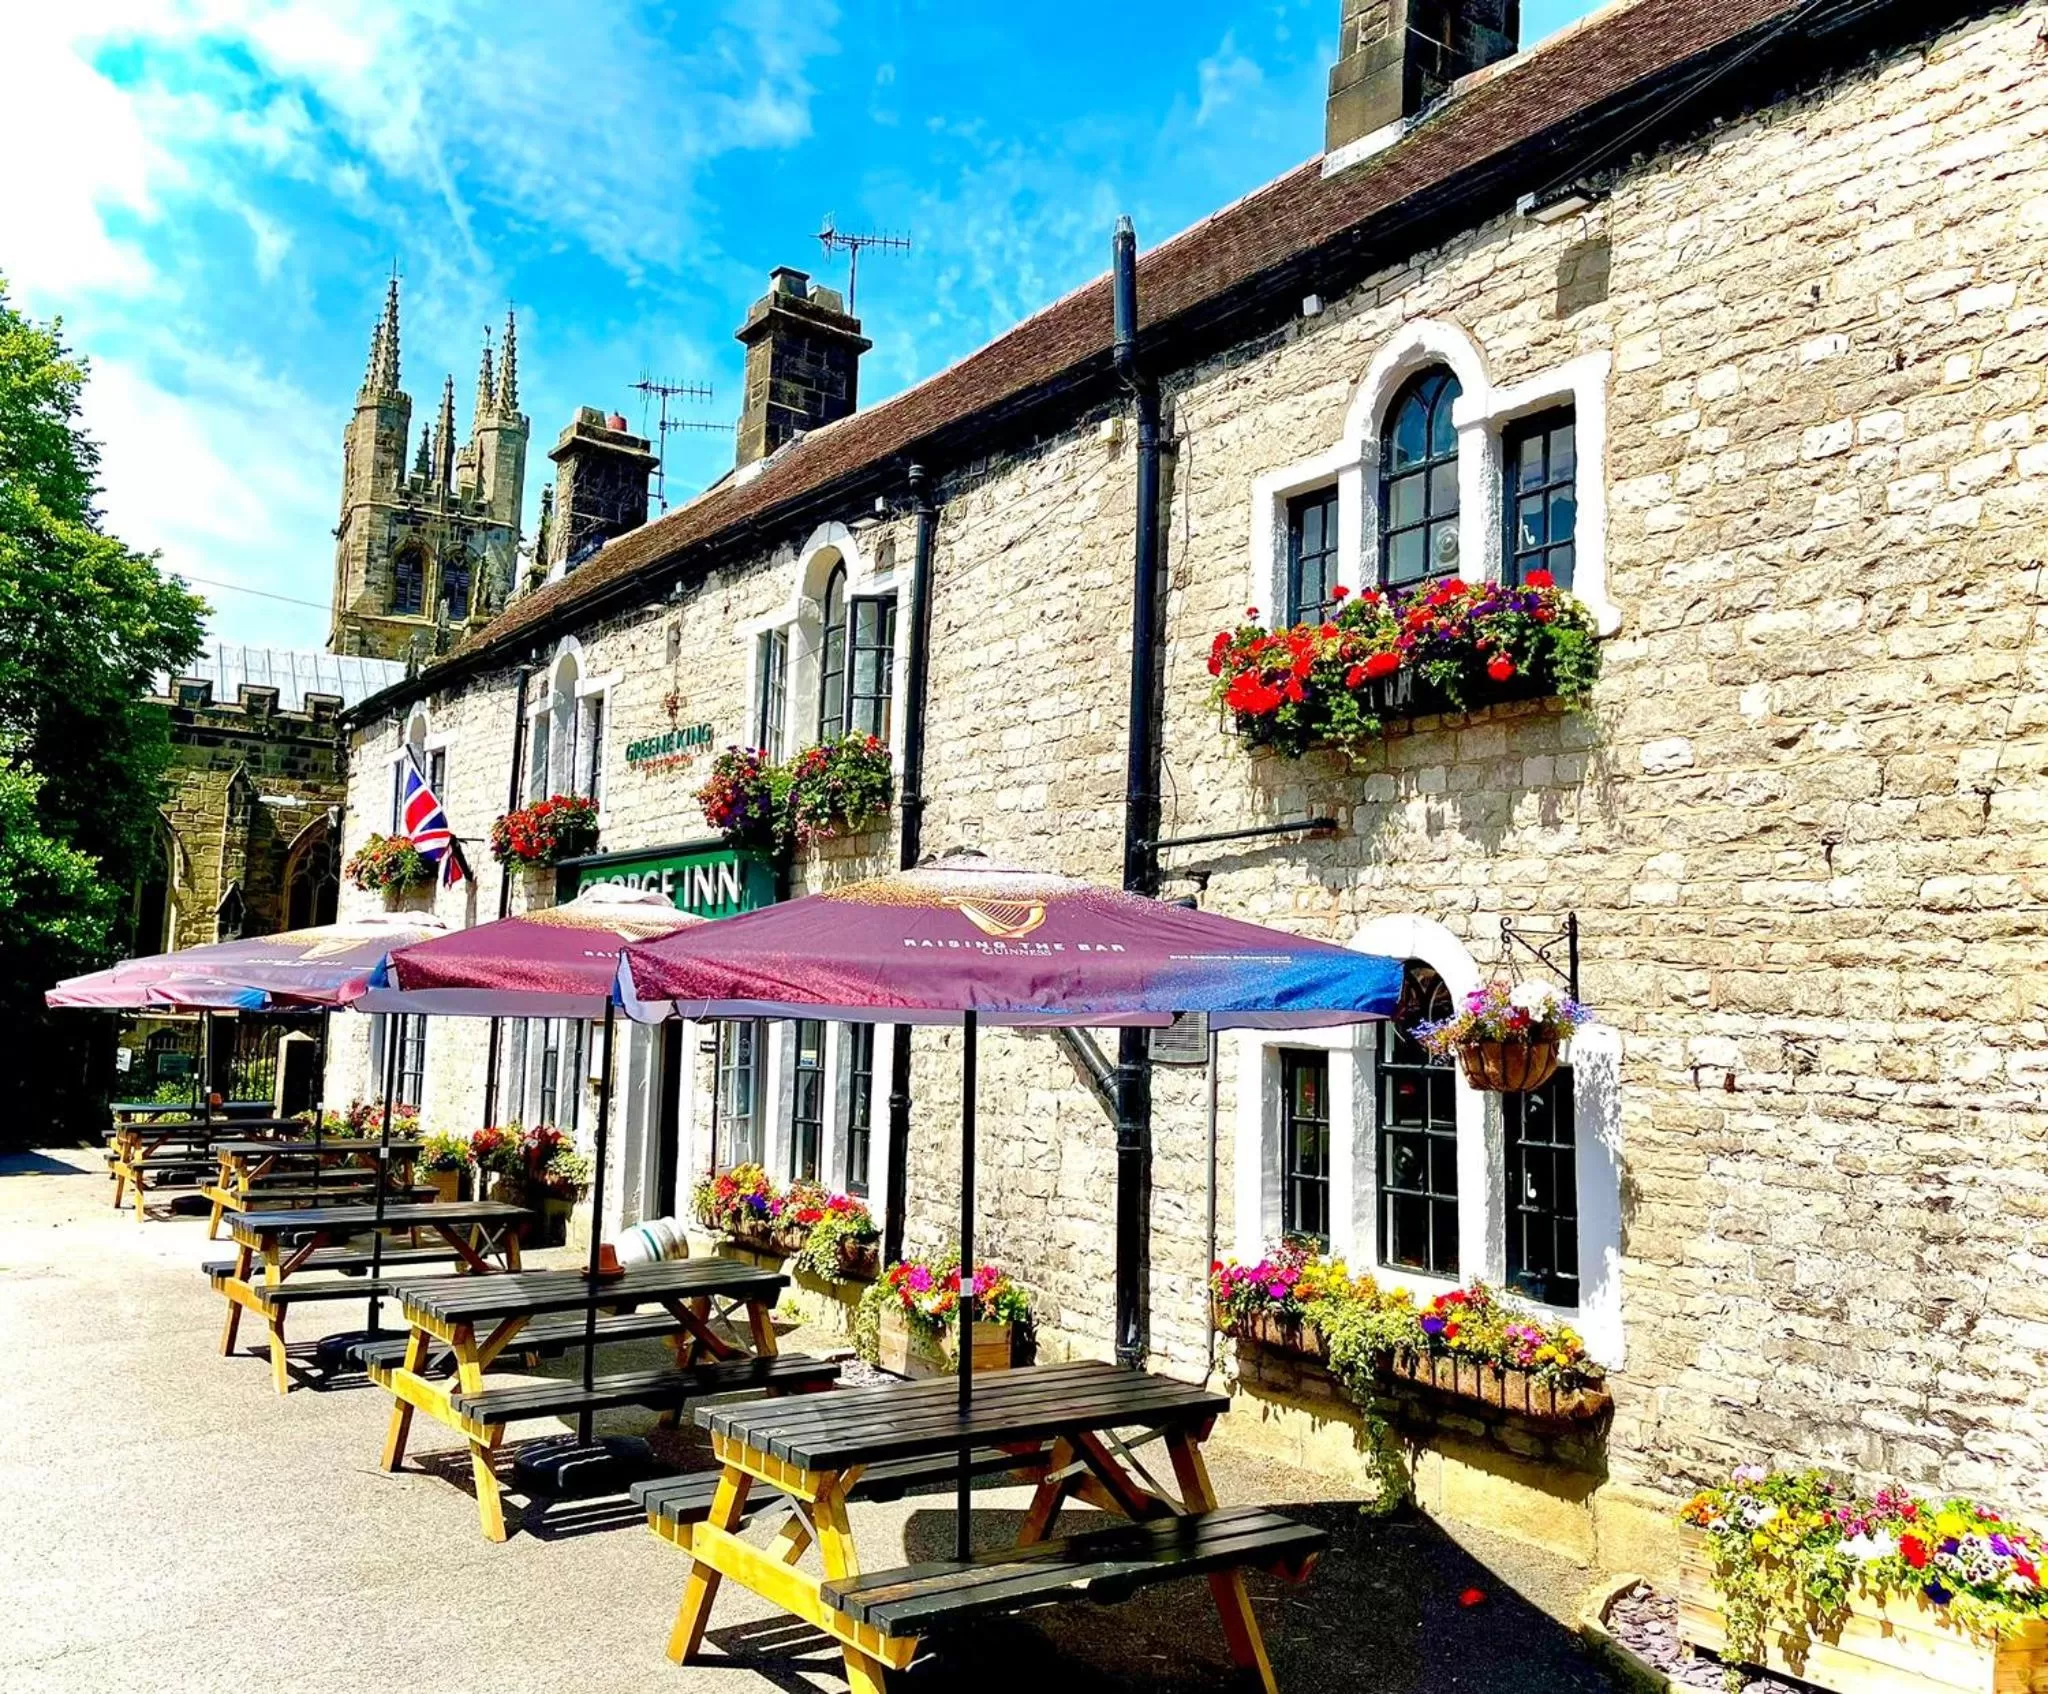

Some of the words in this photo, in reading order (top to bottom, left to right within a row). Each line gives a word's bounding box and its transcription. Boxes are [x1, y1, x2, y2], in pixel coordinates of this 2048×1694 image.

[625, 731, 675, 761] GREENE
[676, 722, 712, 749] KING
[577, 867, 675, 898] GORGE
[683, 858, 740, 908] INN
[902, 938, 1007, 950] RAISING
[1018, 942, 1065, 952] THE
[1077, 944, 1127, 952] BAR
[982, 946, 1052, 956] GUINNESS
